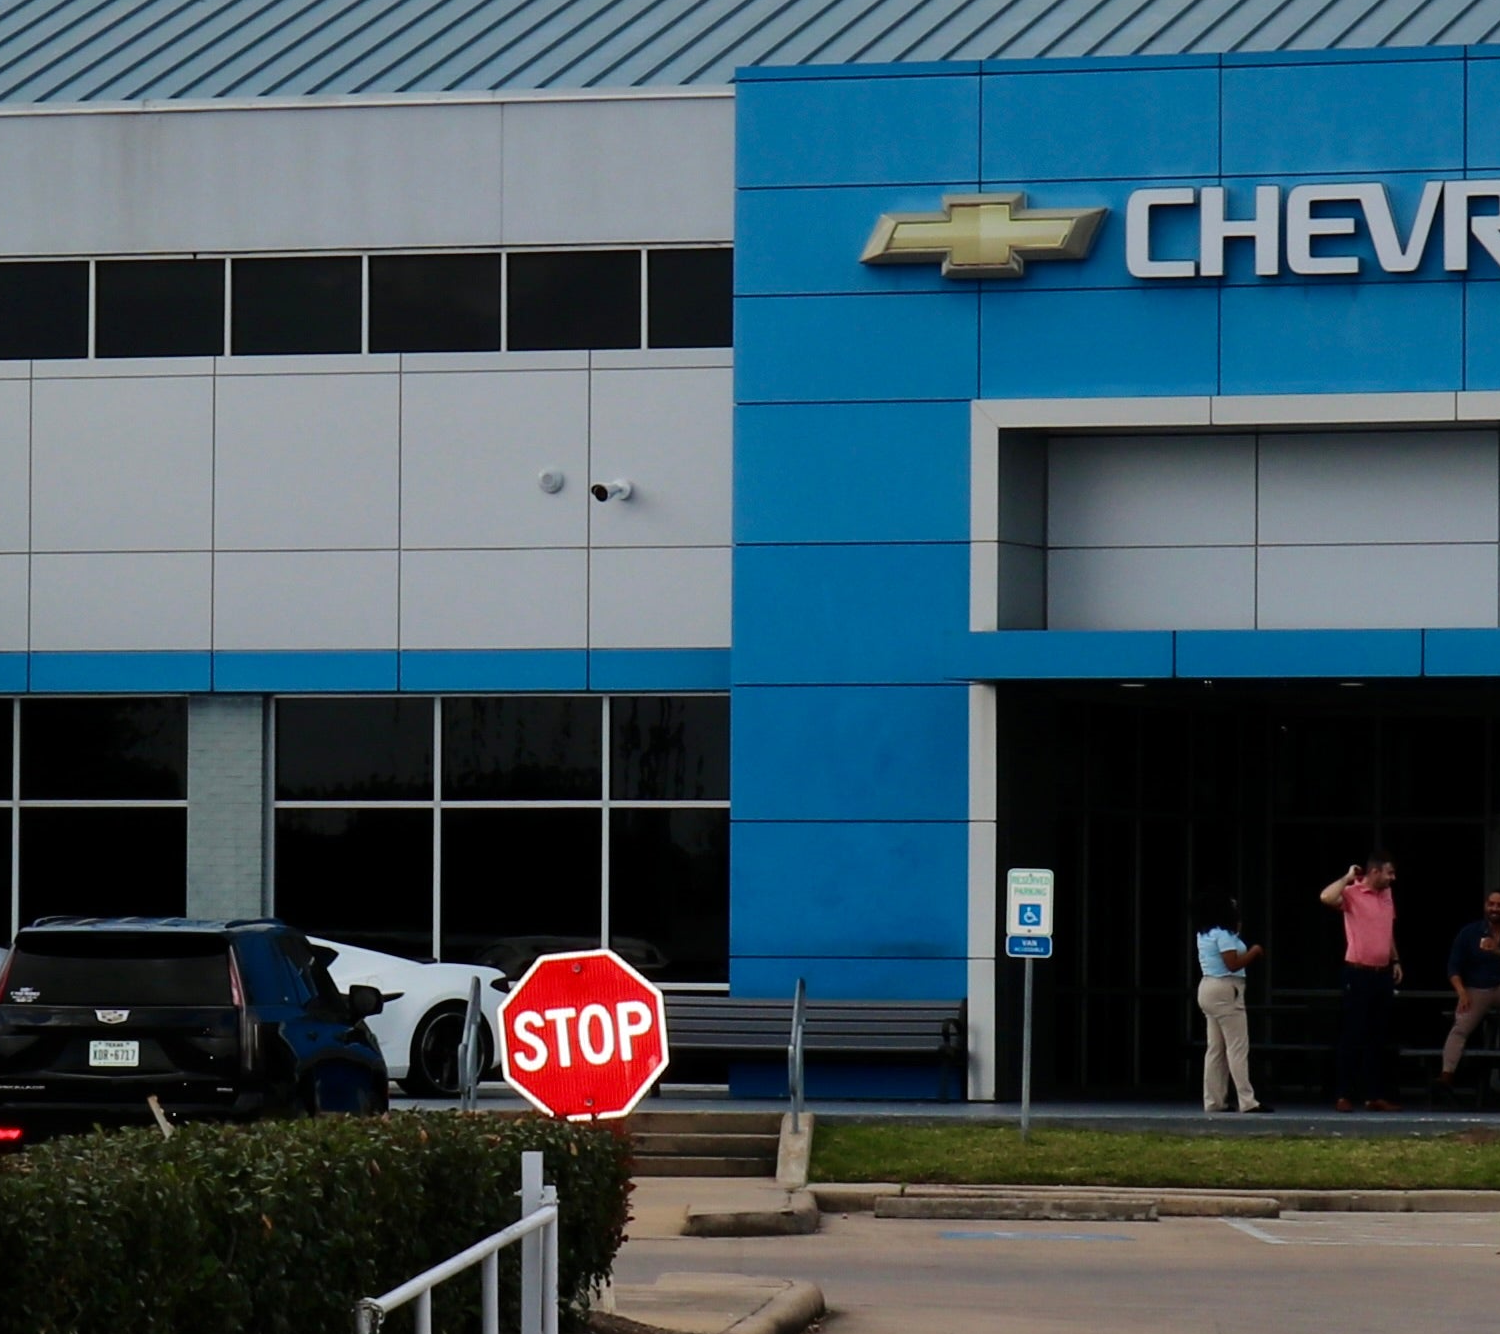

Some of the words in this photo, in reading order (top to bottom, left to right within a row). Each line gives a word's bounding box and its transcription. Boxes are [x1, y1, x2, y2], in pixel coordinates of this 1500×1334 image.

[1010, 875, 1051, 885] RESERVED
[1014, 887, 1048, 896] PARKING
[1022, 939, 1038, 947] VAN
[513, 1000, 653, 1072] STOP
